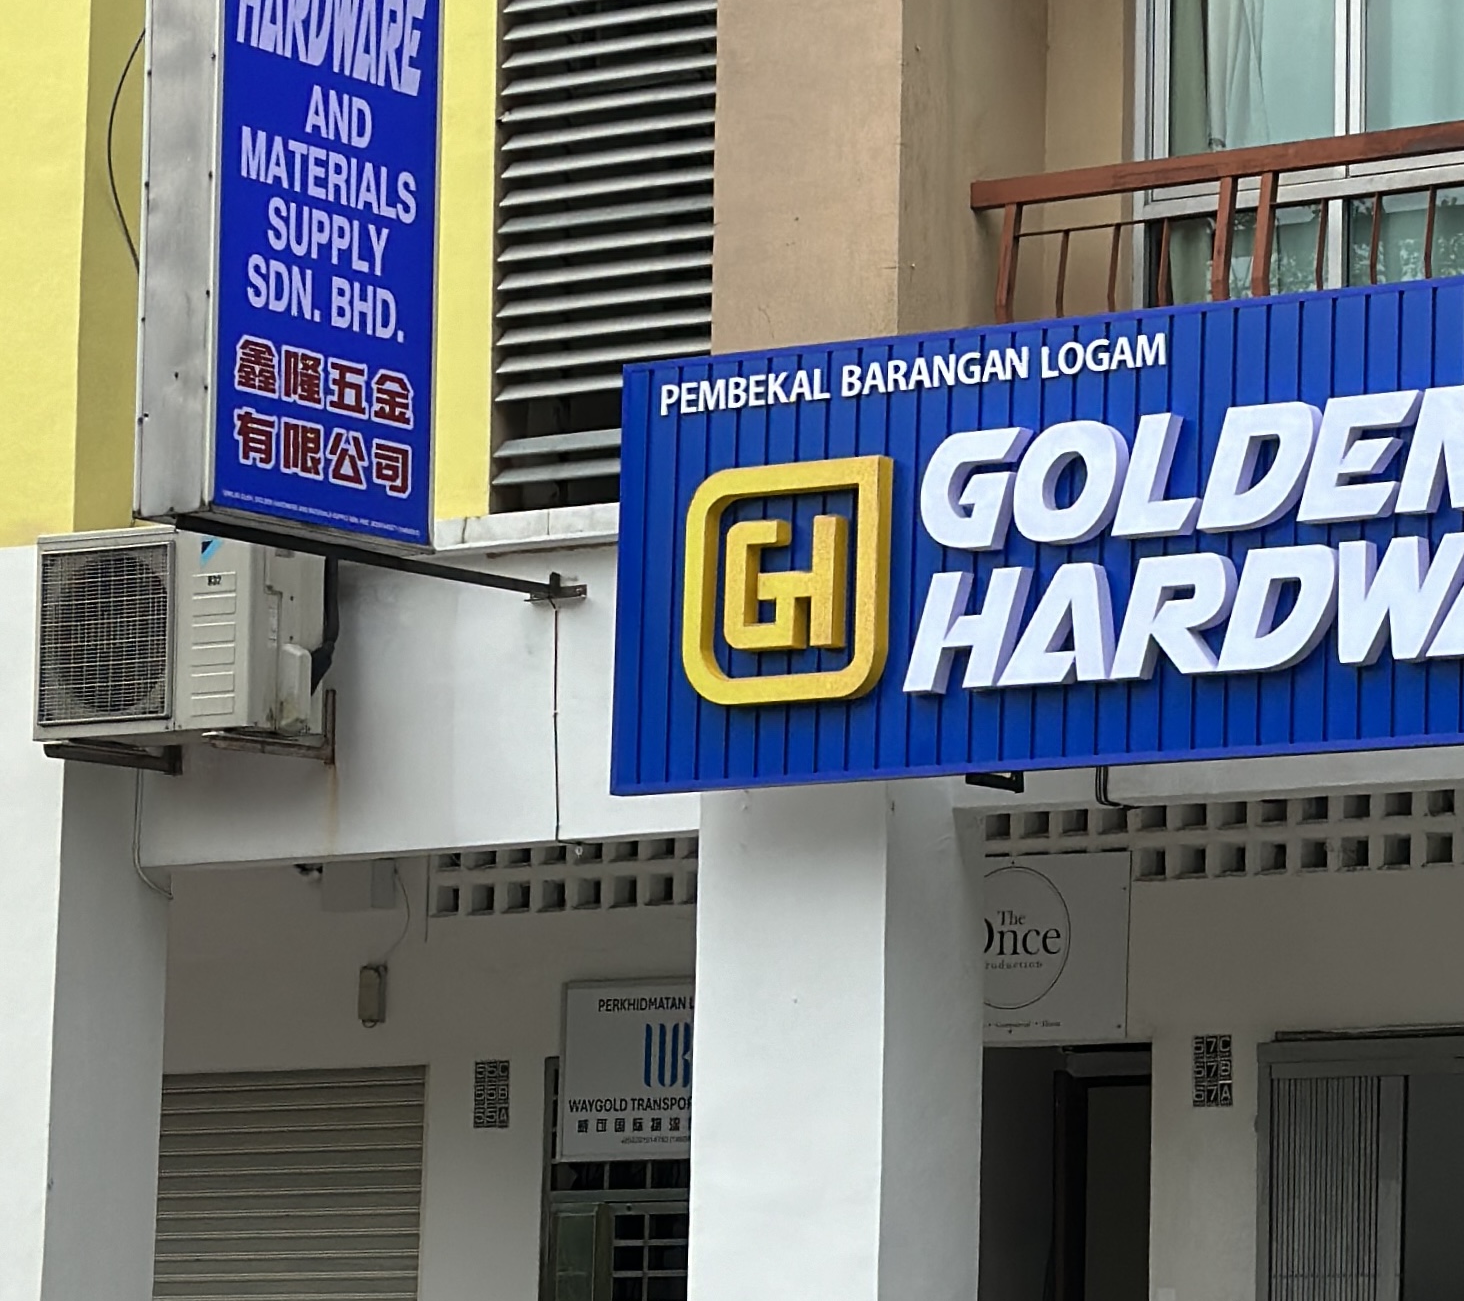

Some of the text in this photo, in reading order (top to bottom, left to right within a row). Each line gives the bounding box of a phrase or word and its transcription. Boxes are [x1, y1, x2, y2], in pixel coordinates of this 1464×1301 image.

[305, 84, 372, 149] AND
[240, 125, 417, 225] MATERIALS
[267, 196, 389, 277] SUPPLY
[247, 254, 405, 344] SDN. BHD.
[233, 334, 414, 431] 鑫隆五金
[659, 332, 1168, 417] PEMBEKAL BARANGAN LOGAM
[233, 406, 413, 500] 有限公司
[997, 910, 1027, 926] The
[598, 997, 687, 1012] PERKHIDMATAN
[1193, 1037, 1231, 1054] 57C
[1193, 1061, 1231, 1077] 57B
[568, 1098, 628, 1113] WAYGOLD
[1193, 1085, 1231, 1101] 57A
